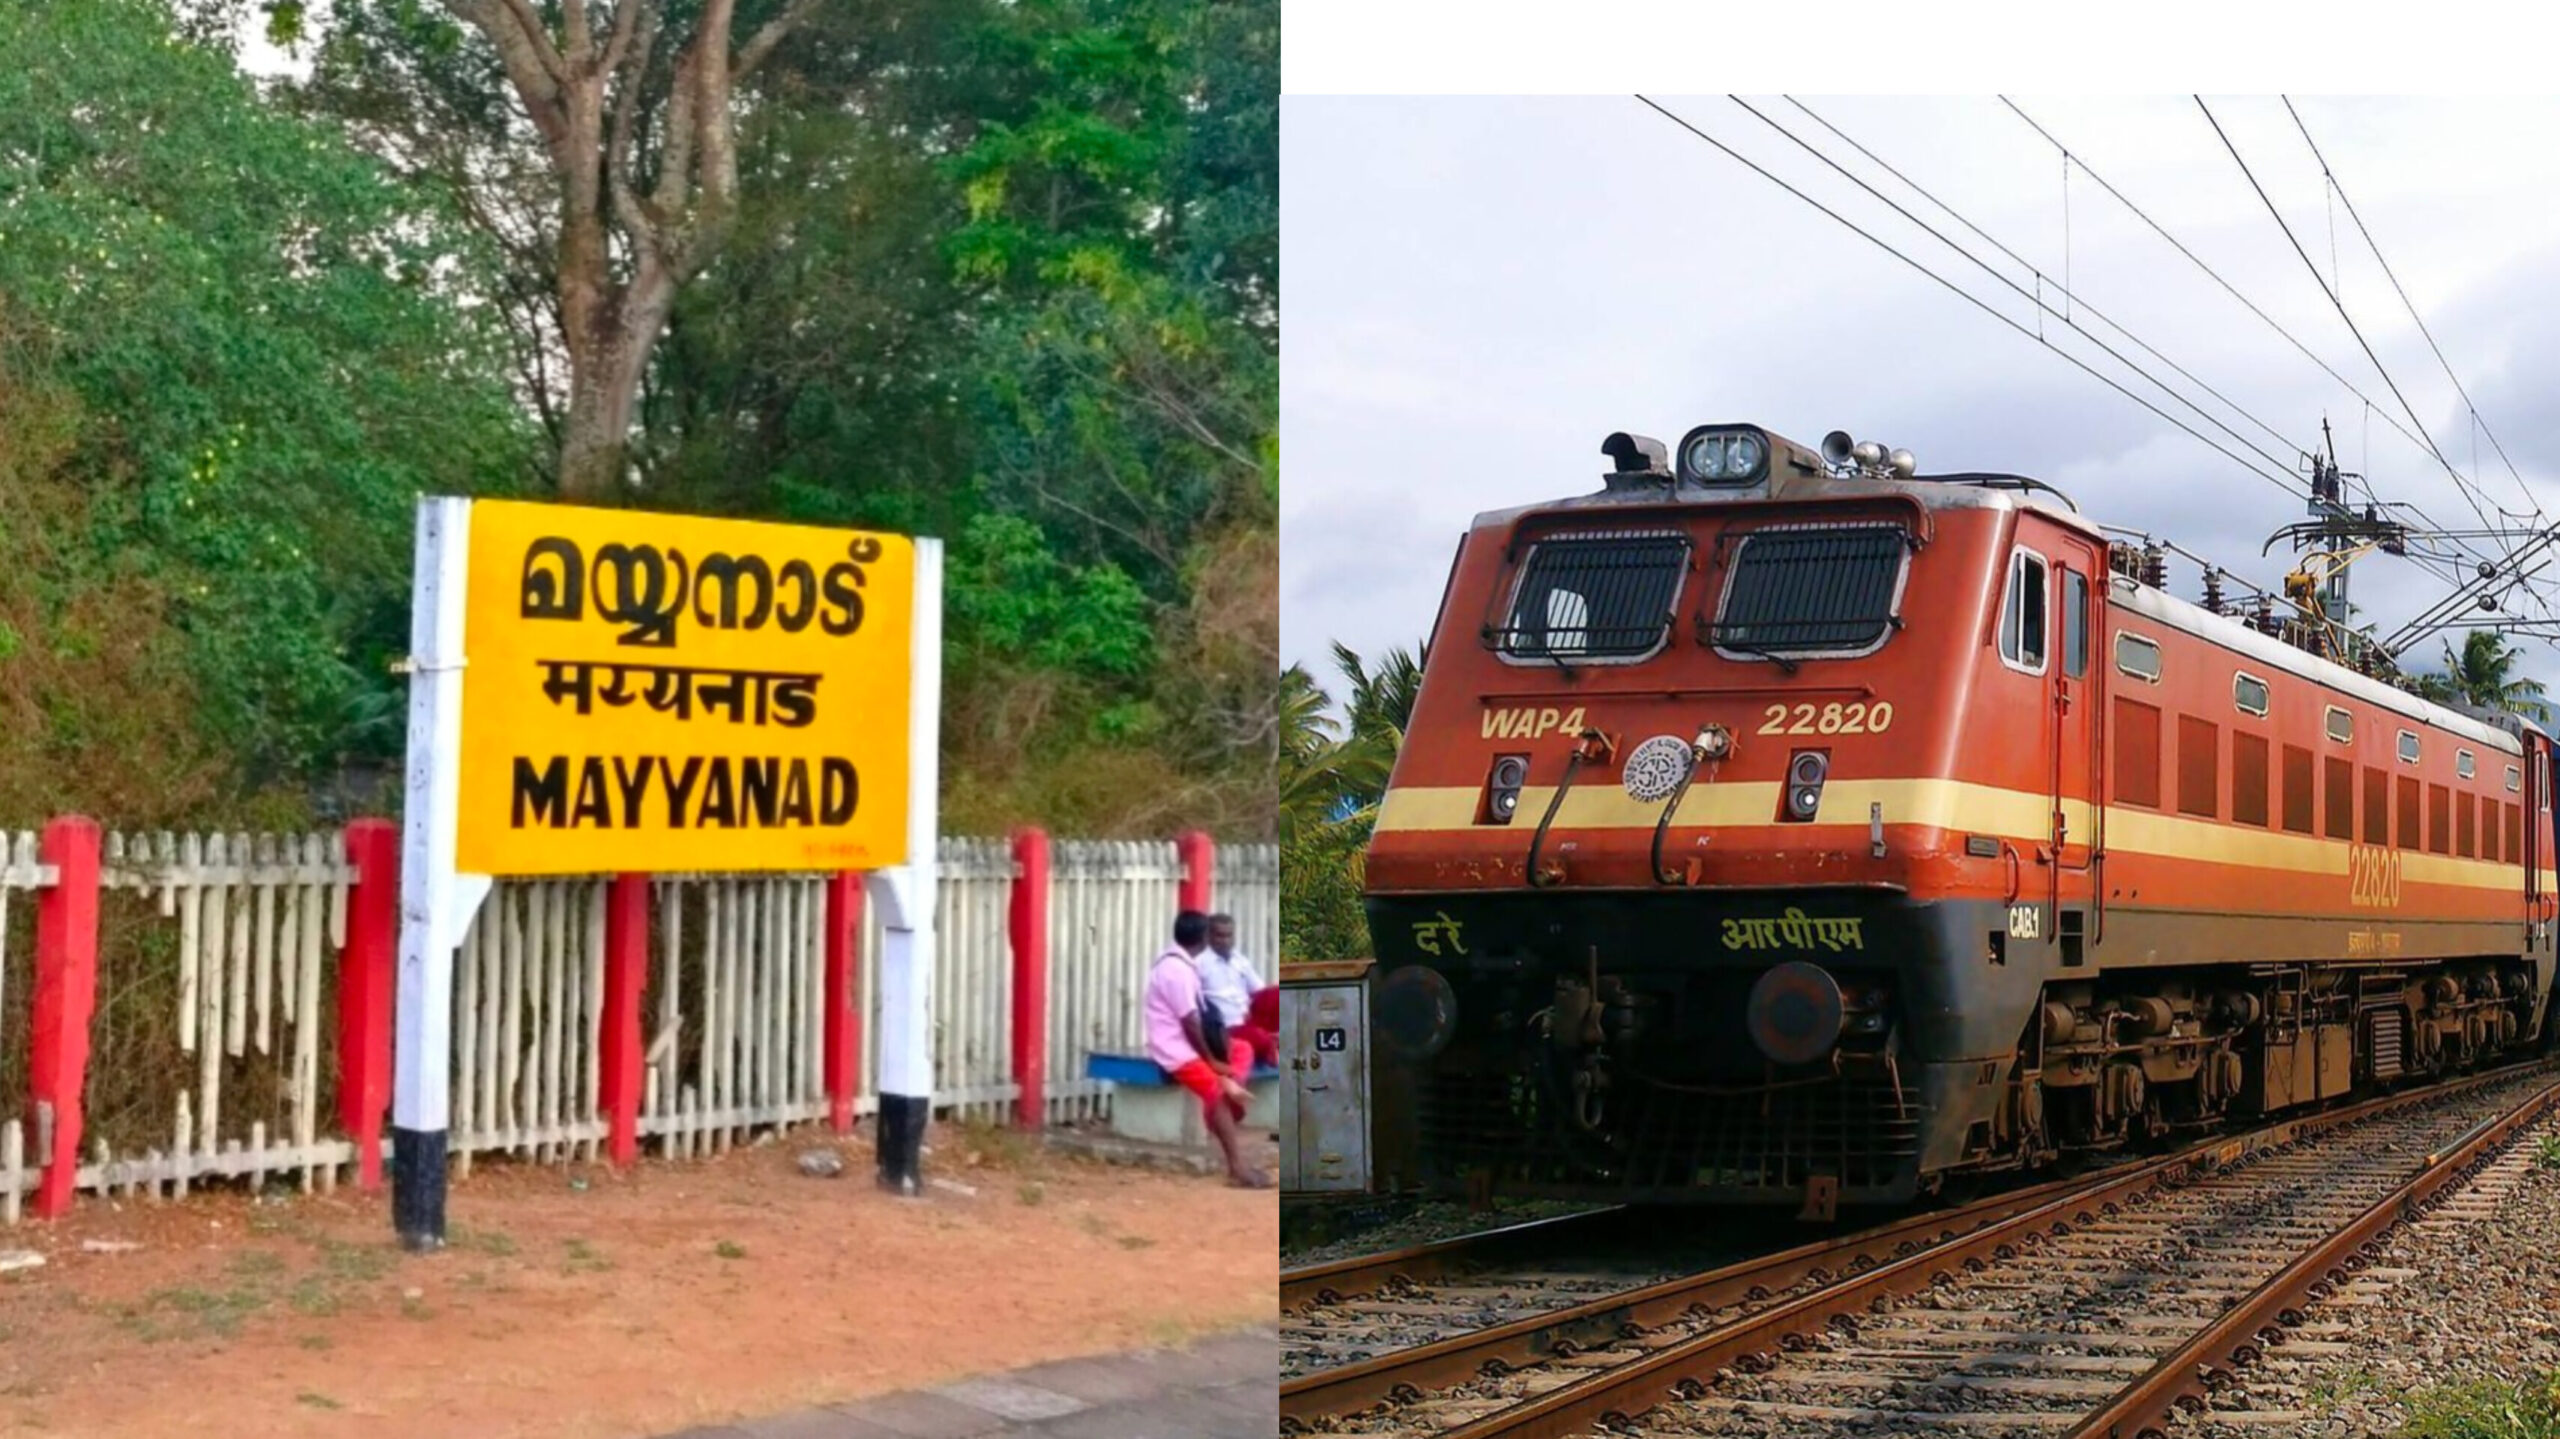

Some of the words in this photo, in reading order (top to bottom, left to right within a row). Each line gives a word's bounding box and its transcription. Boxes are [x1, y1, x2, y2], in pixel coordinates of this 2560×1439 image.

[1481, 707, 1586, 739] WAP4
[1756, 702, 1893, 735] 22820
[510, 755, 860, 829] MAYYANAD
[2351, 845, 2400, 908] 22820
[1721, 906, 1864, 951] आरपीएम
[1319, 1031, 1341, 1049] L4
